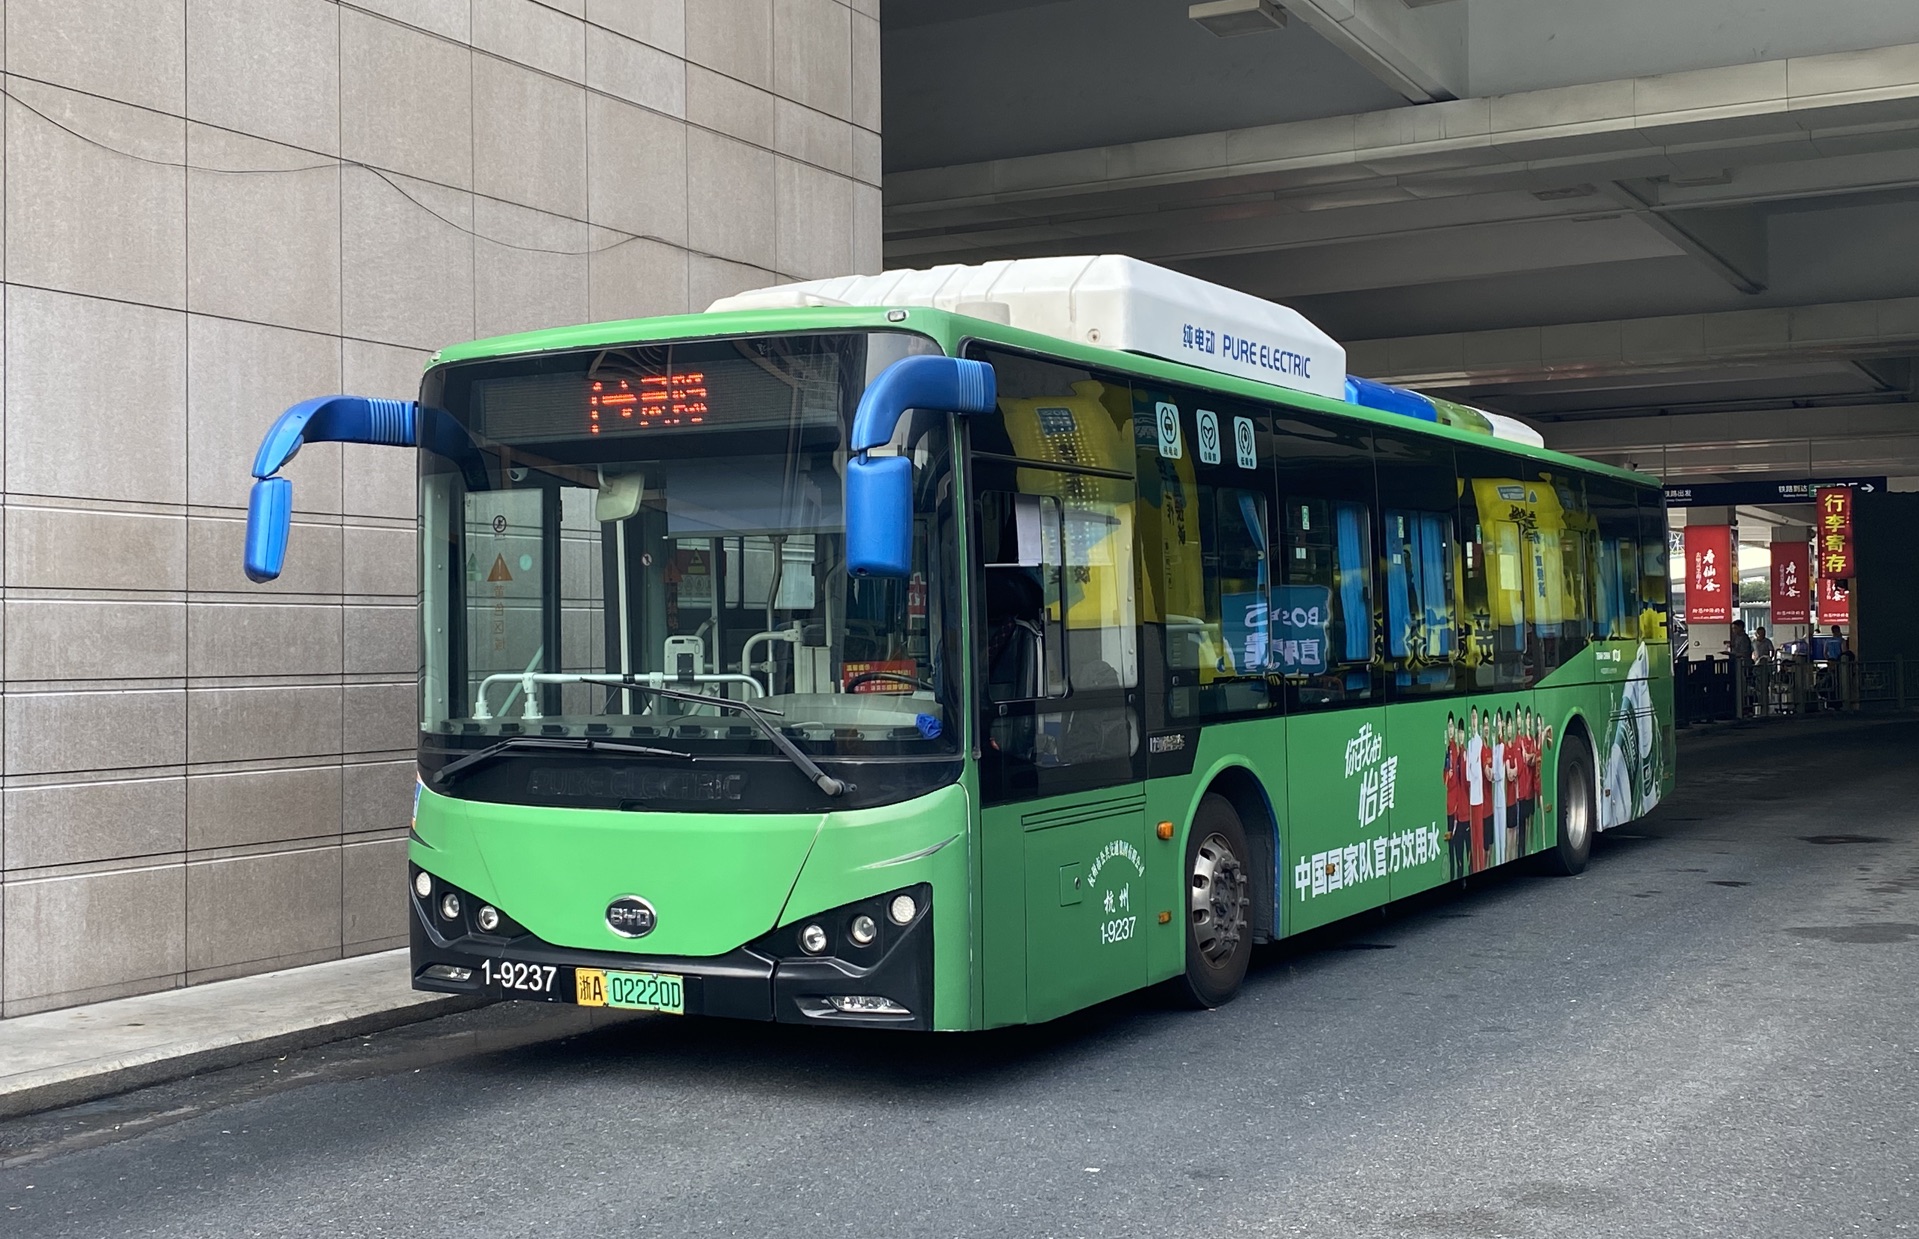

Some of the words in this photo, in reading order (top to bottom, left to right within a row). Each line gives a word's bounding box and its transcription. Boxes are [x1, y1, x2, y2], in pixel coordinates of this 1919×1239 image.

[1183, 323, 1215, 355] 纯电动
[1223, 334, 1257, 365] PURE
[1260, 345, 1311, 379] ELECTRIC
[1825, 494, 1847, 573] 行李寄存
[1345, 722, 1383, 778] 你我的
[1295, 821, 1441, 902] 中国国家队官方饮用水
[1103, 882, 1130, 915] 杭州
[610, 907, 651, 926] BYD
[1101, 916, 1136, 945] 1-9237
[481, 959, 557, 992] 1-9237
